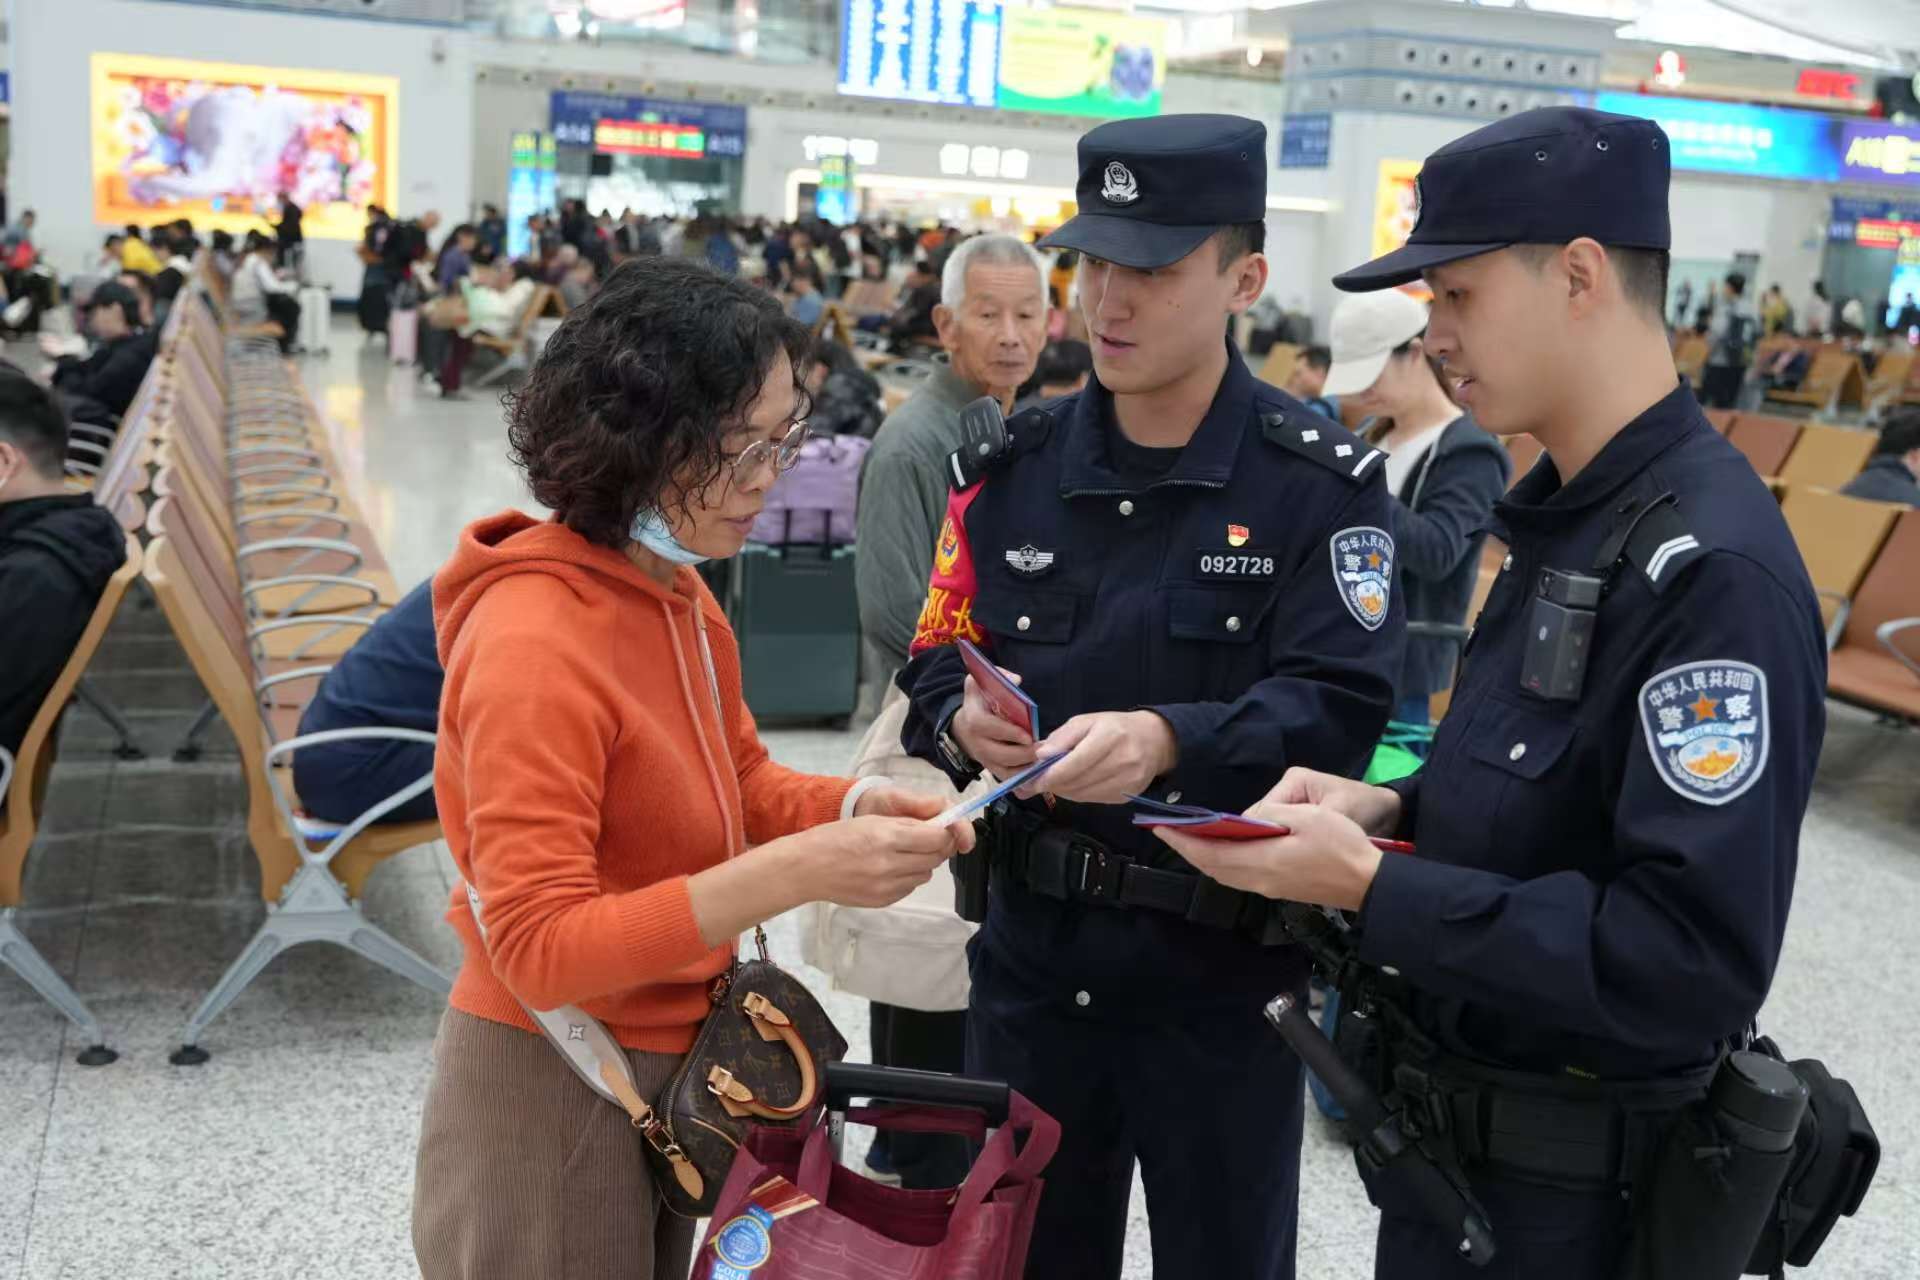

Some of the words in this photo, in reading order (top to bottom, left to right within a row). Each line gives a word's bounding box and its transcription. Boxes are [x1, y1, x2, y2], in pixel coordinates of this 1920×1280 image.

[1200, 555, 1274, 575] 092728
[1648, 669, 1755, 707] 中华人民共和国
